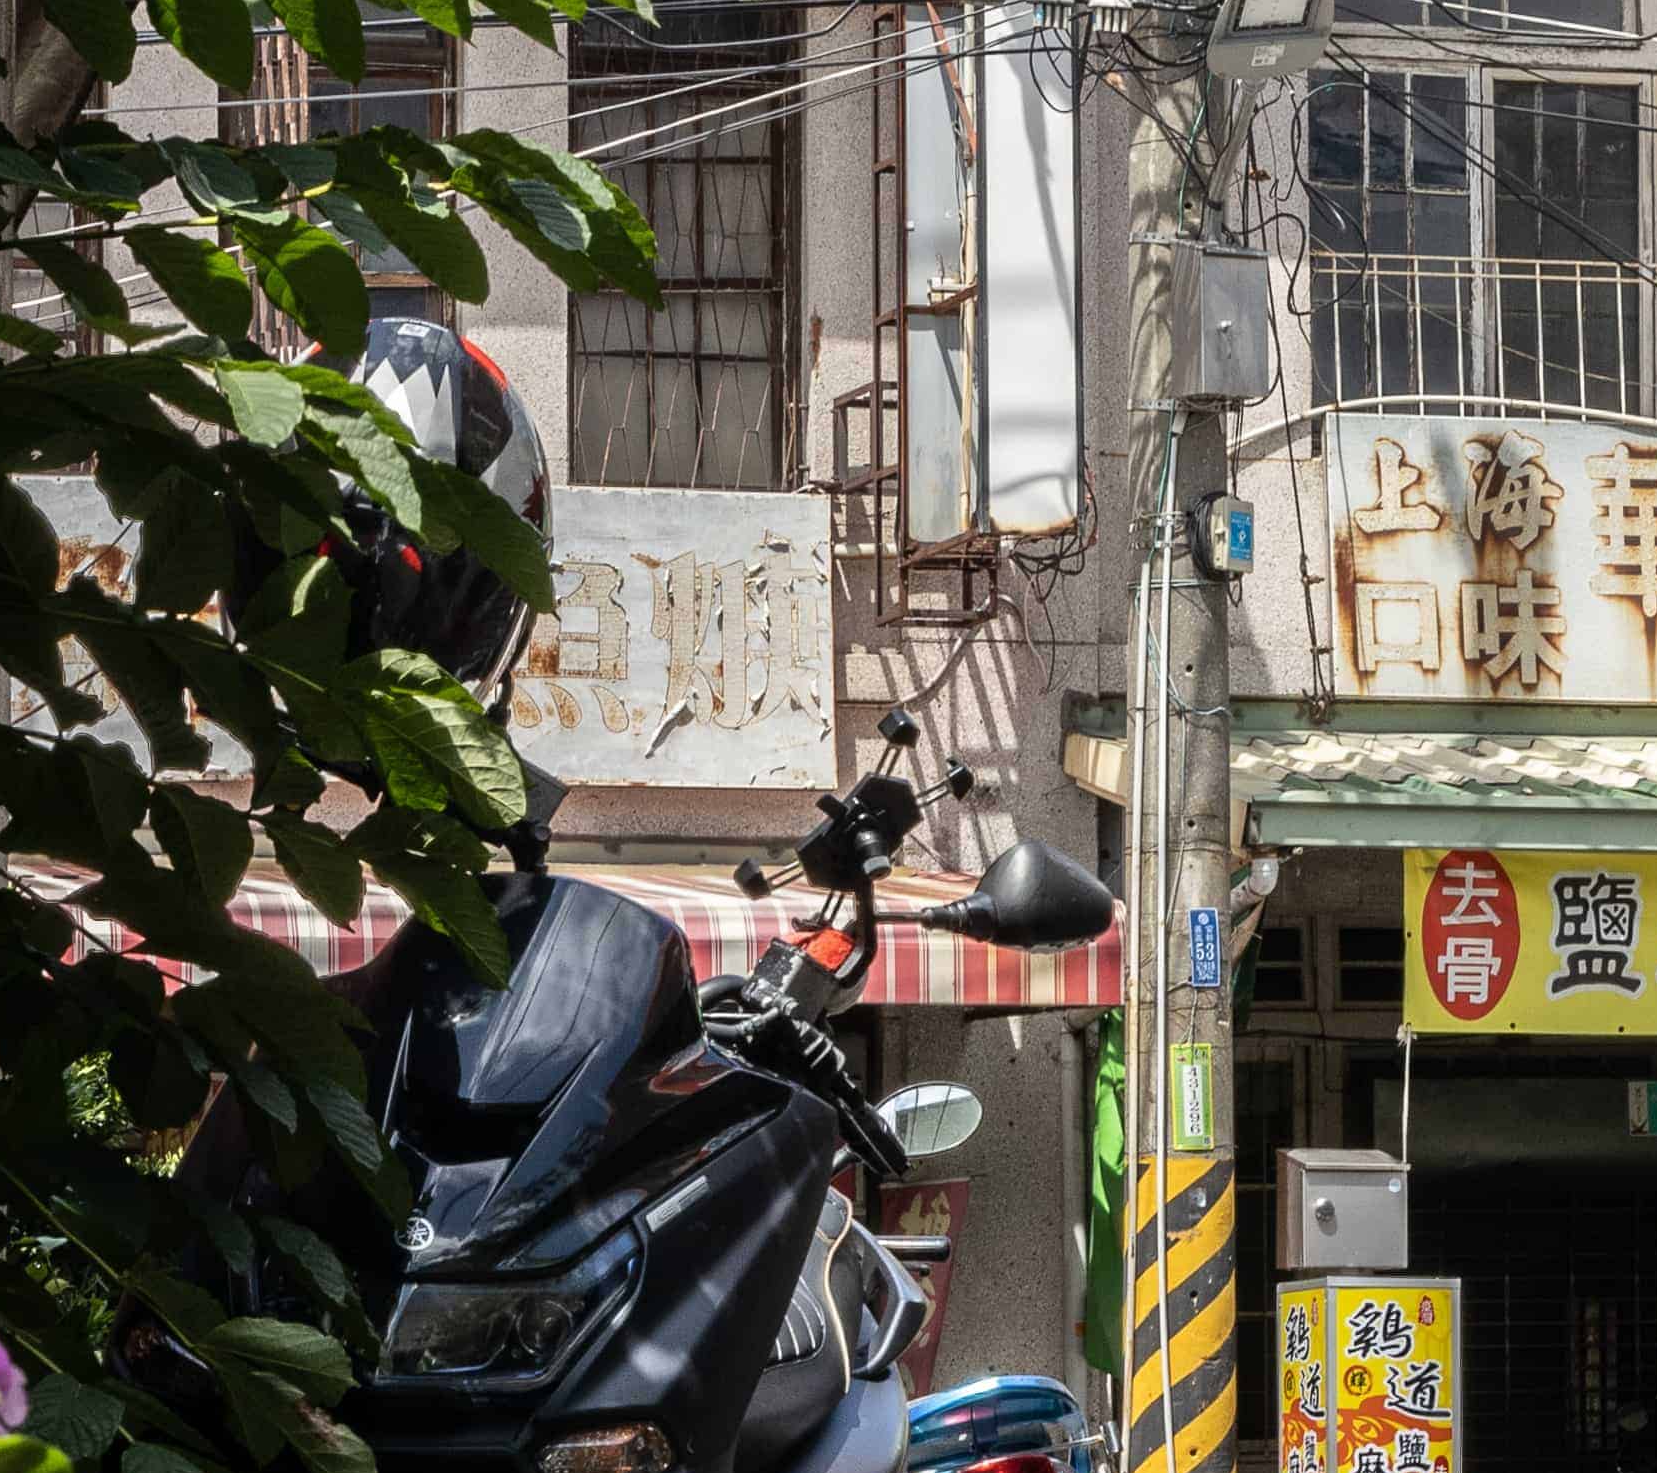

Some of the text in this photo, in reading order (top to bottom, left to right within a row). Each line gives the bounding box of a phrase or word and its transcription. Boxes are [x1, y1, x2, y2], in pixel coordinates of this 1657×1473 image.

[1354, 431, 1563, 553] 上海
[1354, 569, 1567, 686] 口味
[1437, 860, 1503, 1005] 去骨
